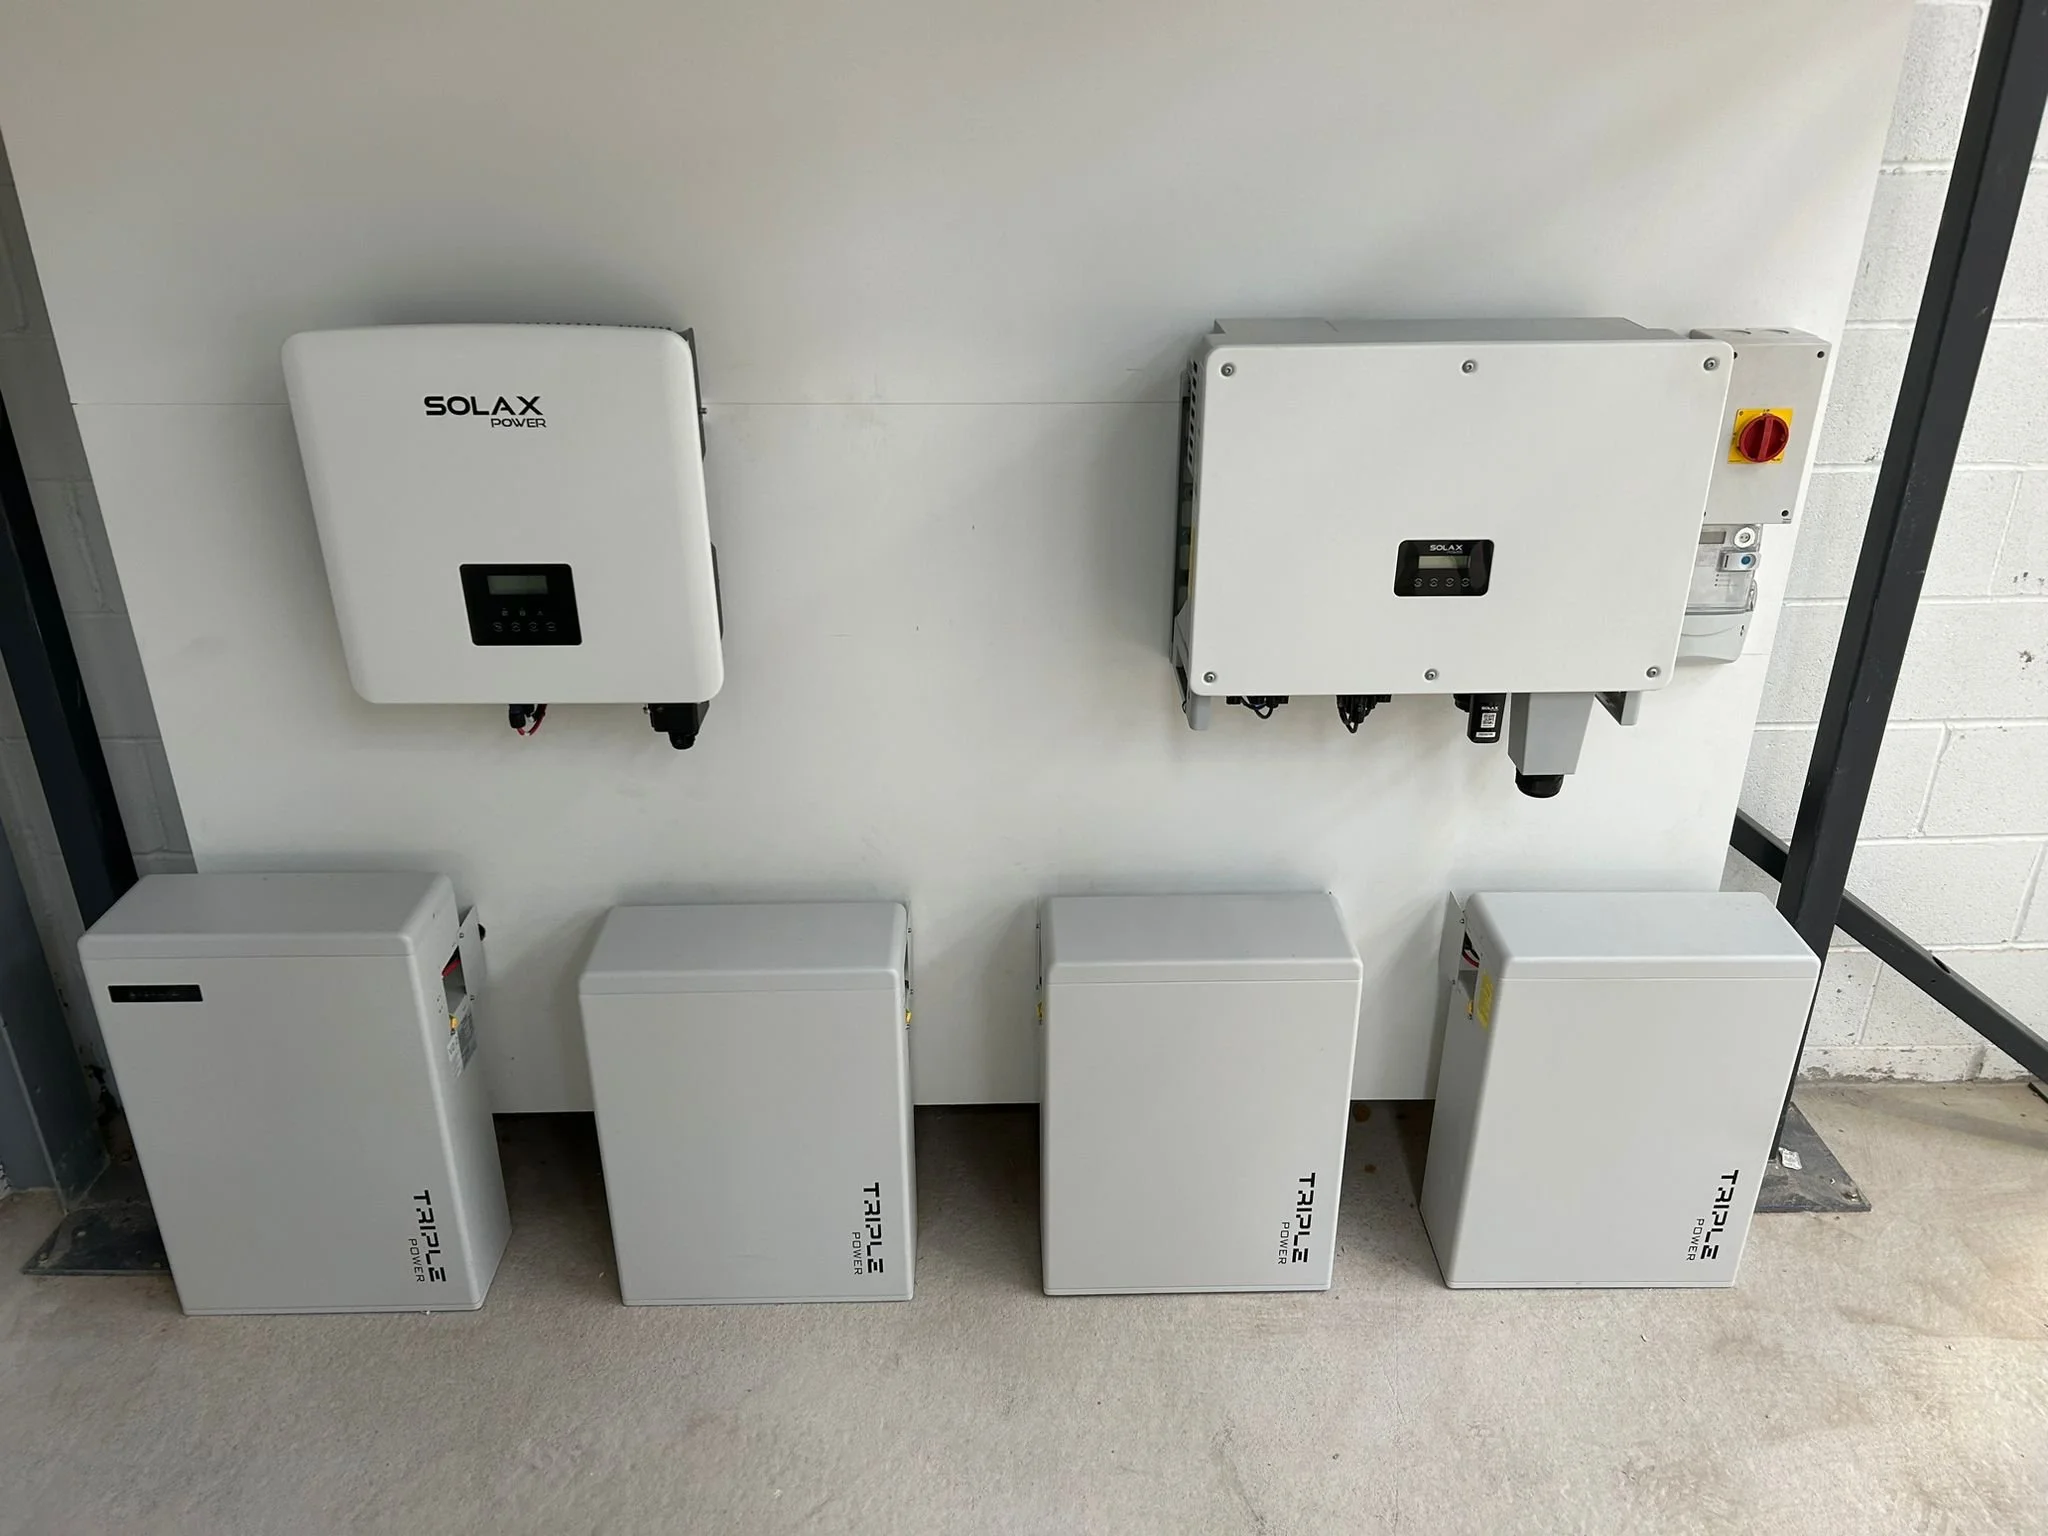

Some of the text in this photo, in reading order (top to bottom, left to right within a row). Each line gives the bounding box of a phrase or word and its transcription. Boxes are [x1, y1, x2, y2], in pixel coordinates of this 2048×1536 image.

[424, 396, 543, 416] SOLAX
[490, 418, 547, 428] POWER
[413, 1190, 447, 1282] TRIPLE
[863, 1182, 884, 1273] TRIPLE
[1292, 1172, 1316, 1262] TRIPLE
[1700, 1169, 1739, 1259] TRIPLE
[408, 1238, 425, 1282] POWER
[852, 1231, 863, 1275] POWER
[1278, 1221, 1290, 1265] POWER
[1686, 1218, 1705, 1260] POWER
